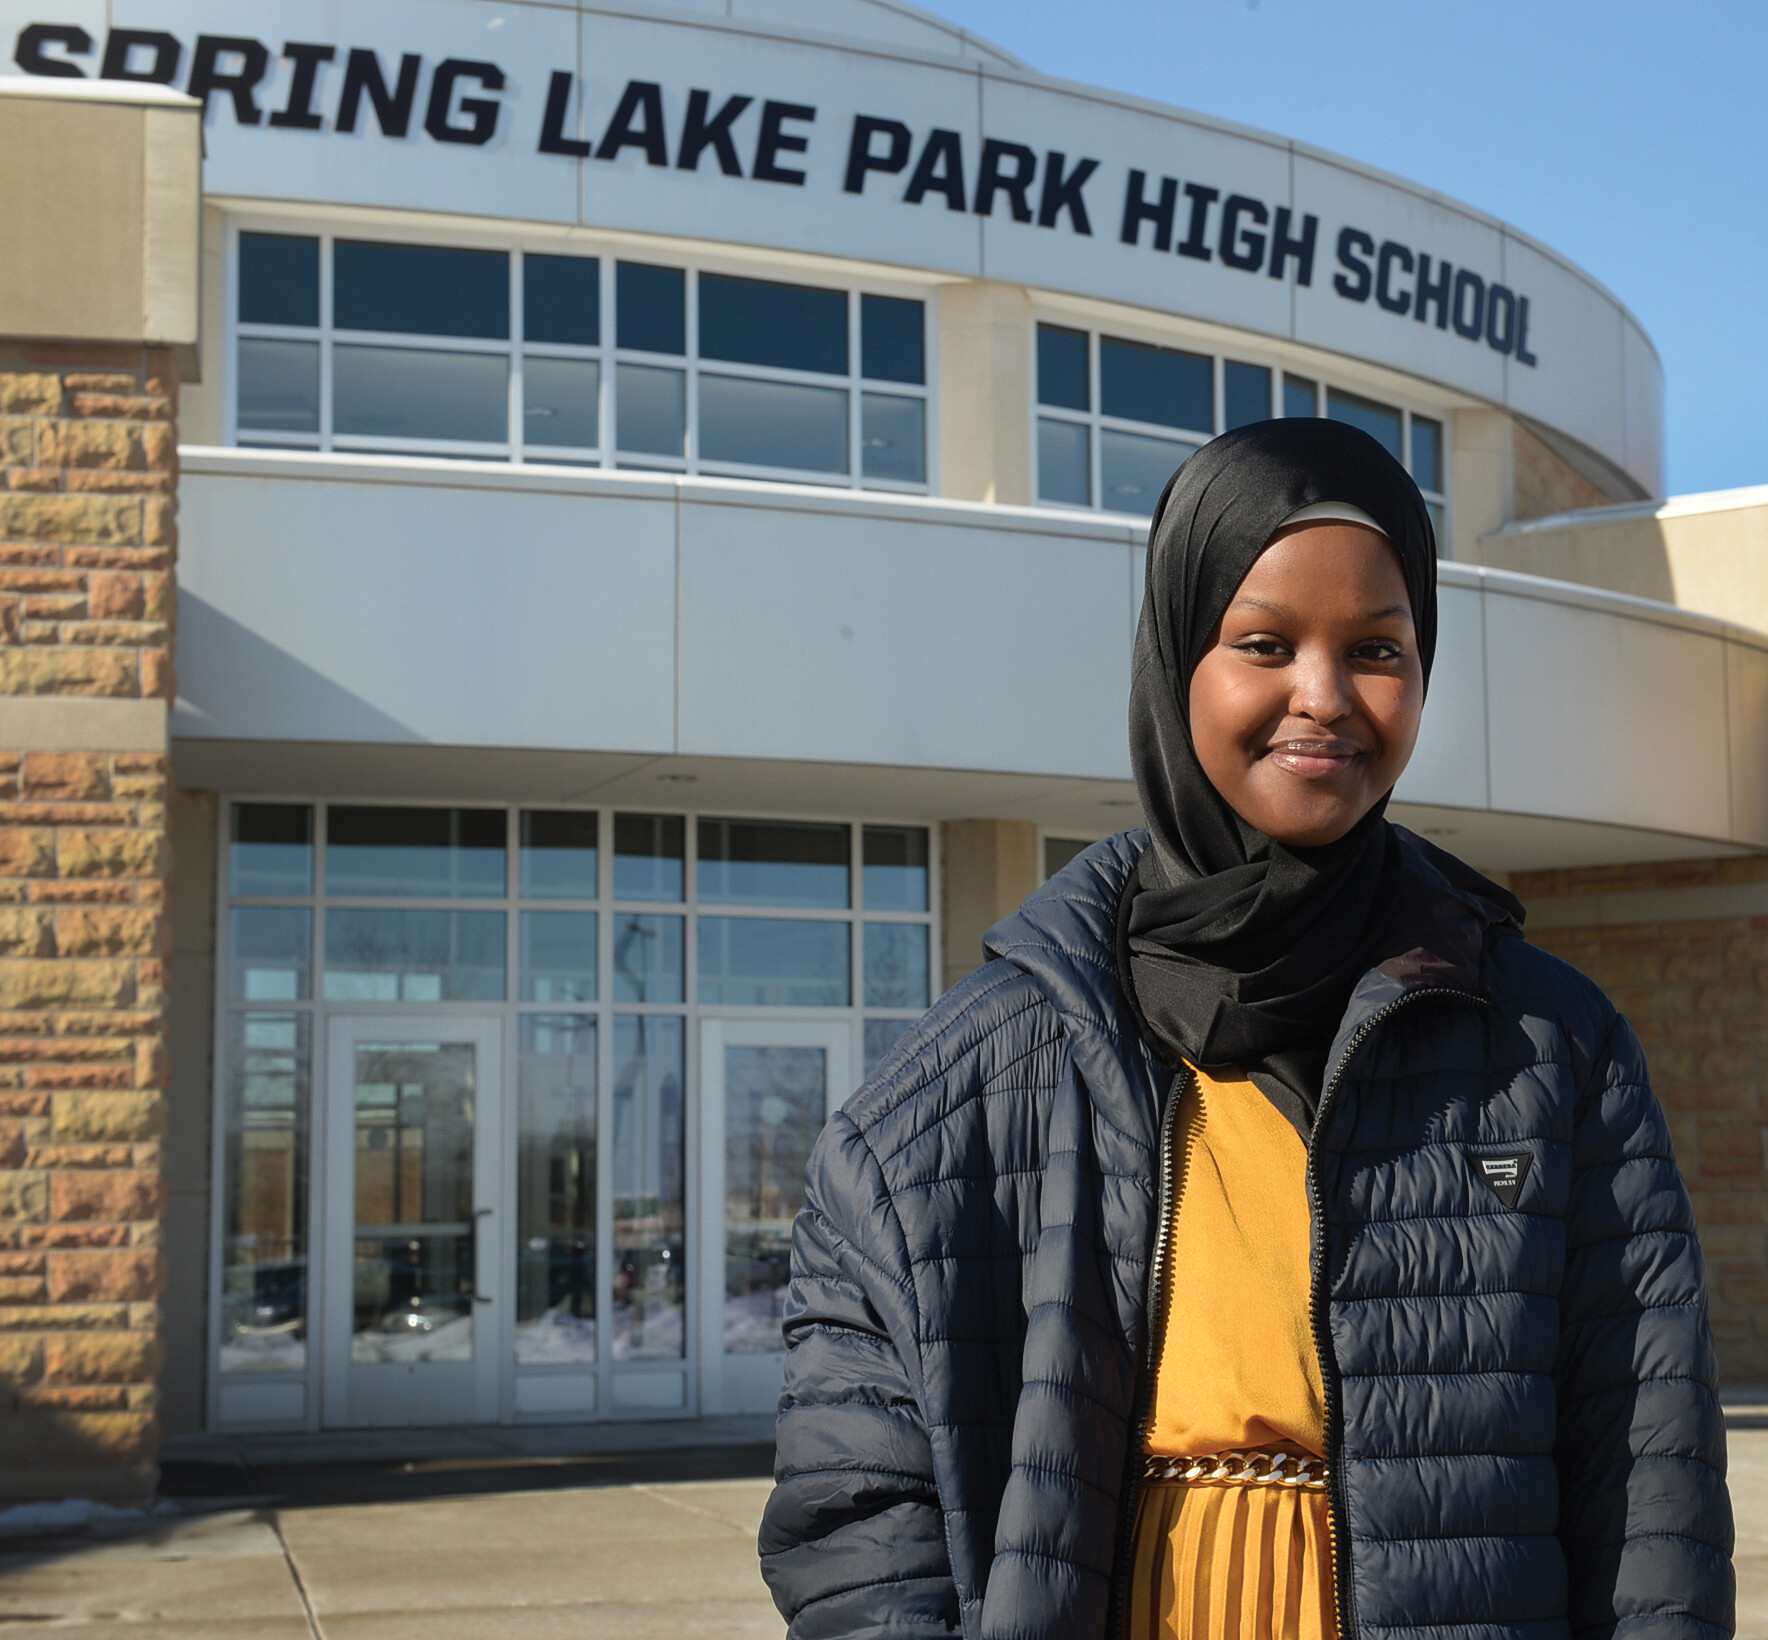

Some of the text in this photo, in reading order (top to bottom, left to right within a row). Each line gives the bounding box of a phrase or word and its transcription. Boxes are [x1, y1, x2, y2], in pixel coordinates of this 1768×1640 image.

[14, 23, 1538, 368] SPRING LAKE PARK HIGH SCHOOL
